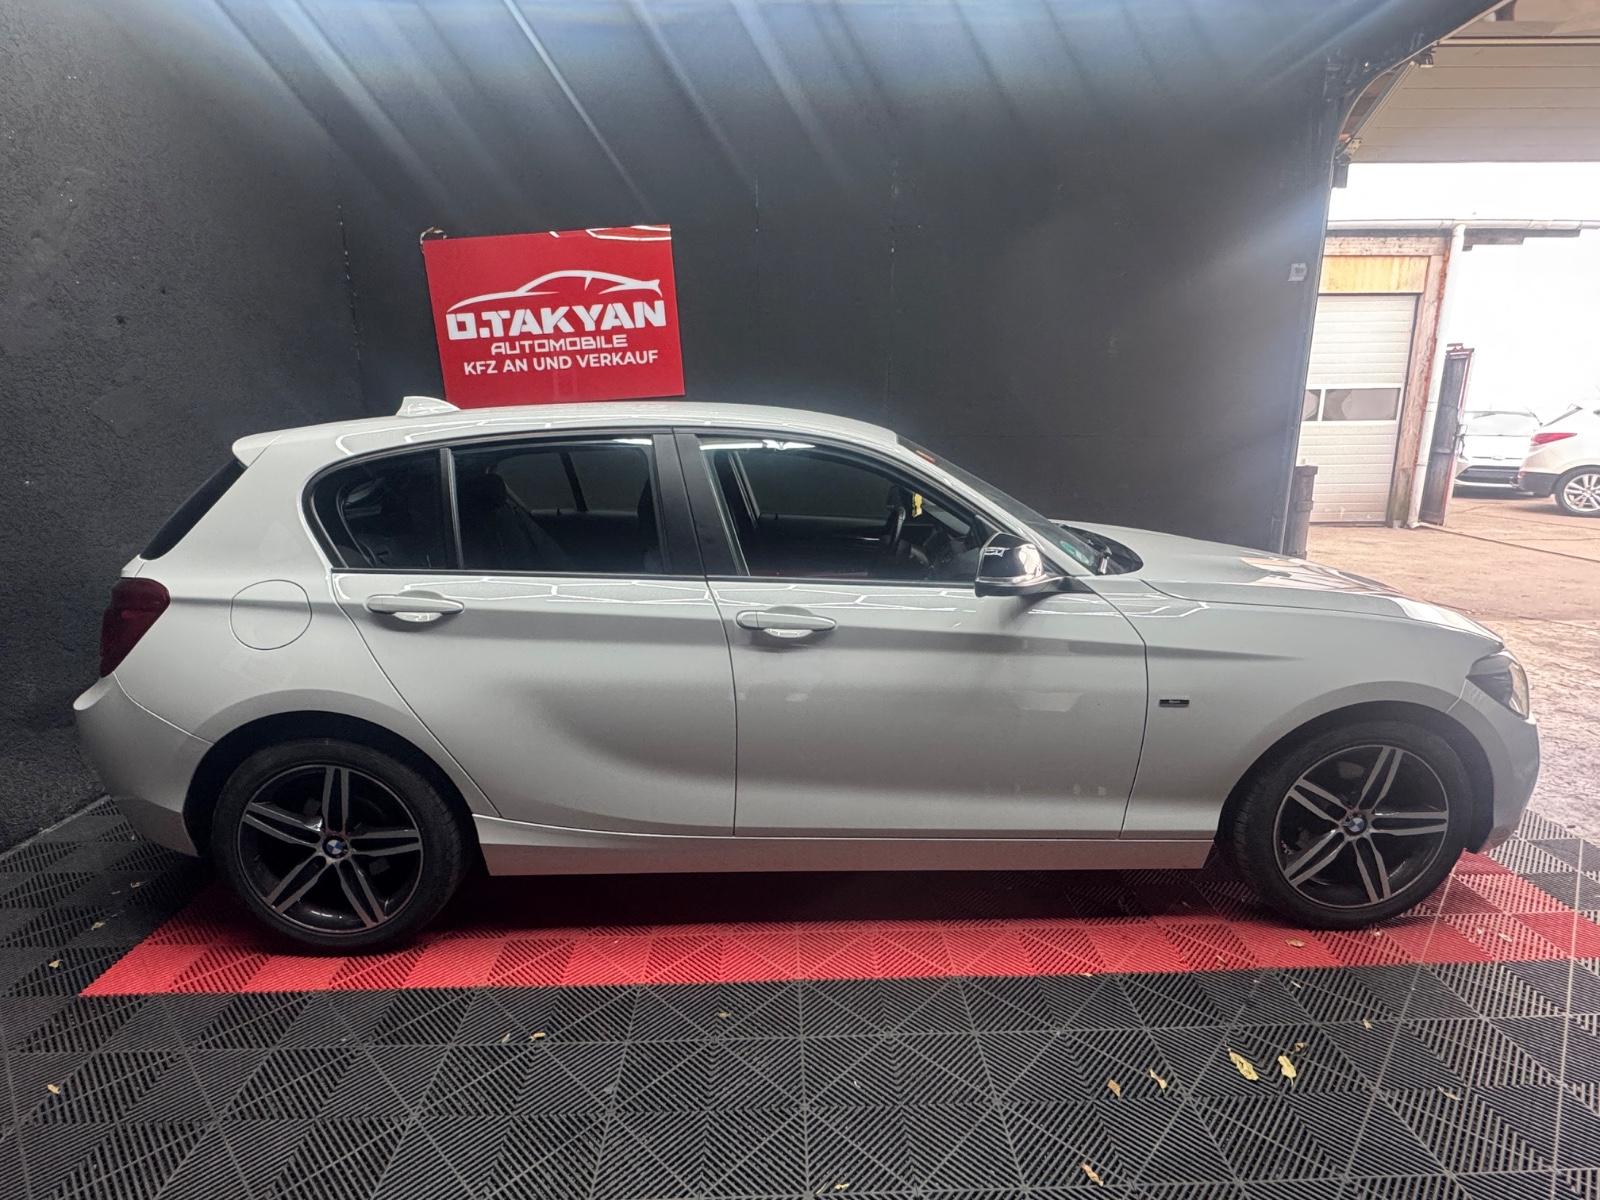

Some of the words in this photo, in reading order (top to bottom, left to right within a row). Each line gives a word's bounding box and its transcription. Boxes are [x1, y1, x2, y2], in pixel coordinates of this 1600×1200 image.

[490, 334, 628, 356] AUTOMOBILE
[463, 360, 498, 375] KFZ
[503, 358, 528, 373] AN
[533, 355, 573, 371] UND
[576, 350, 659, 369] VERKAUF
